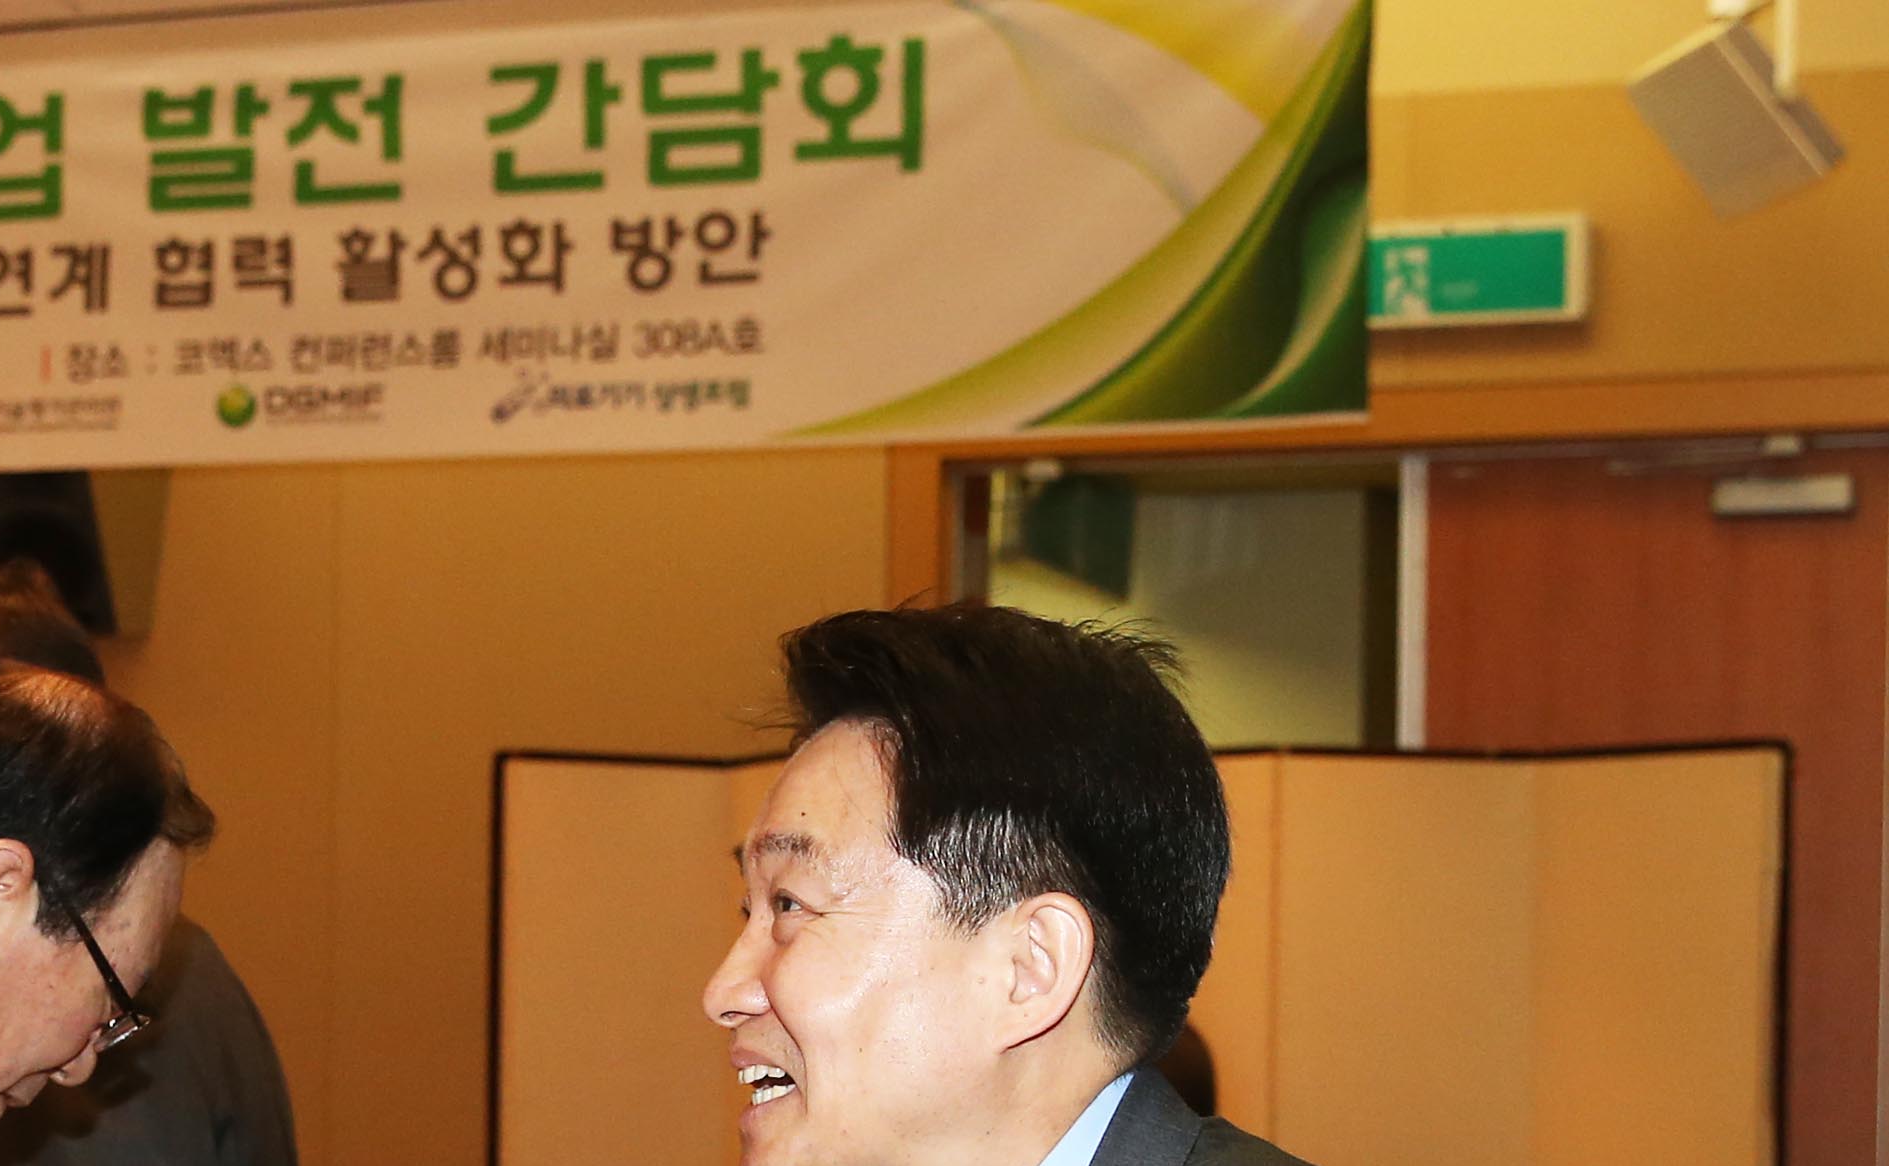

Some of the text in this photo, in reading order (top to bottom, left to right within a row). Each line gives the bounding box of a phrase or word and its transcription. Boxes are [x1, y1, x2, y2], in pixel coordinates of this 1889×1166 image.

[141, 72, 405, 213] 발전
[486, 34, 926, 196] 간담회
[153, 236, 296, 311] 협력
[335, 217, 575, 304] 활성화
[609, 210, 772, 288] 방안
[65, 341, 129, 385] 장소
[174, 336, 273, 375] 코엑스
[478, 322, 620, 364] 세미나실
[635, 314, 765, 359] 308A호
